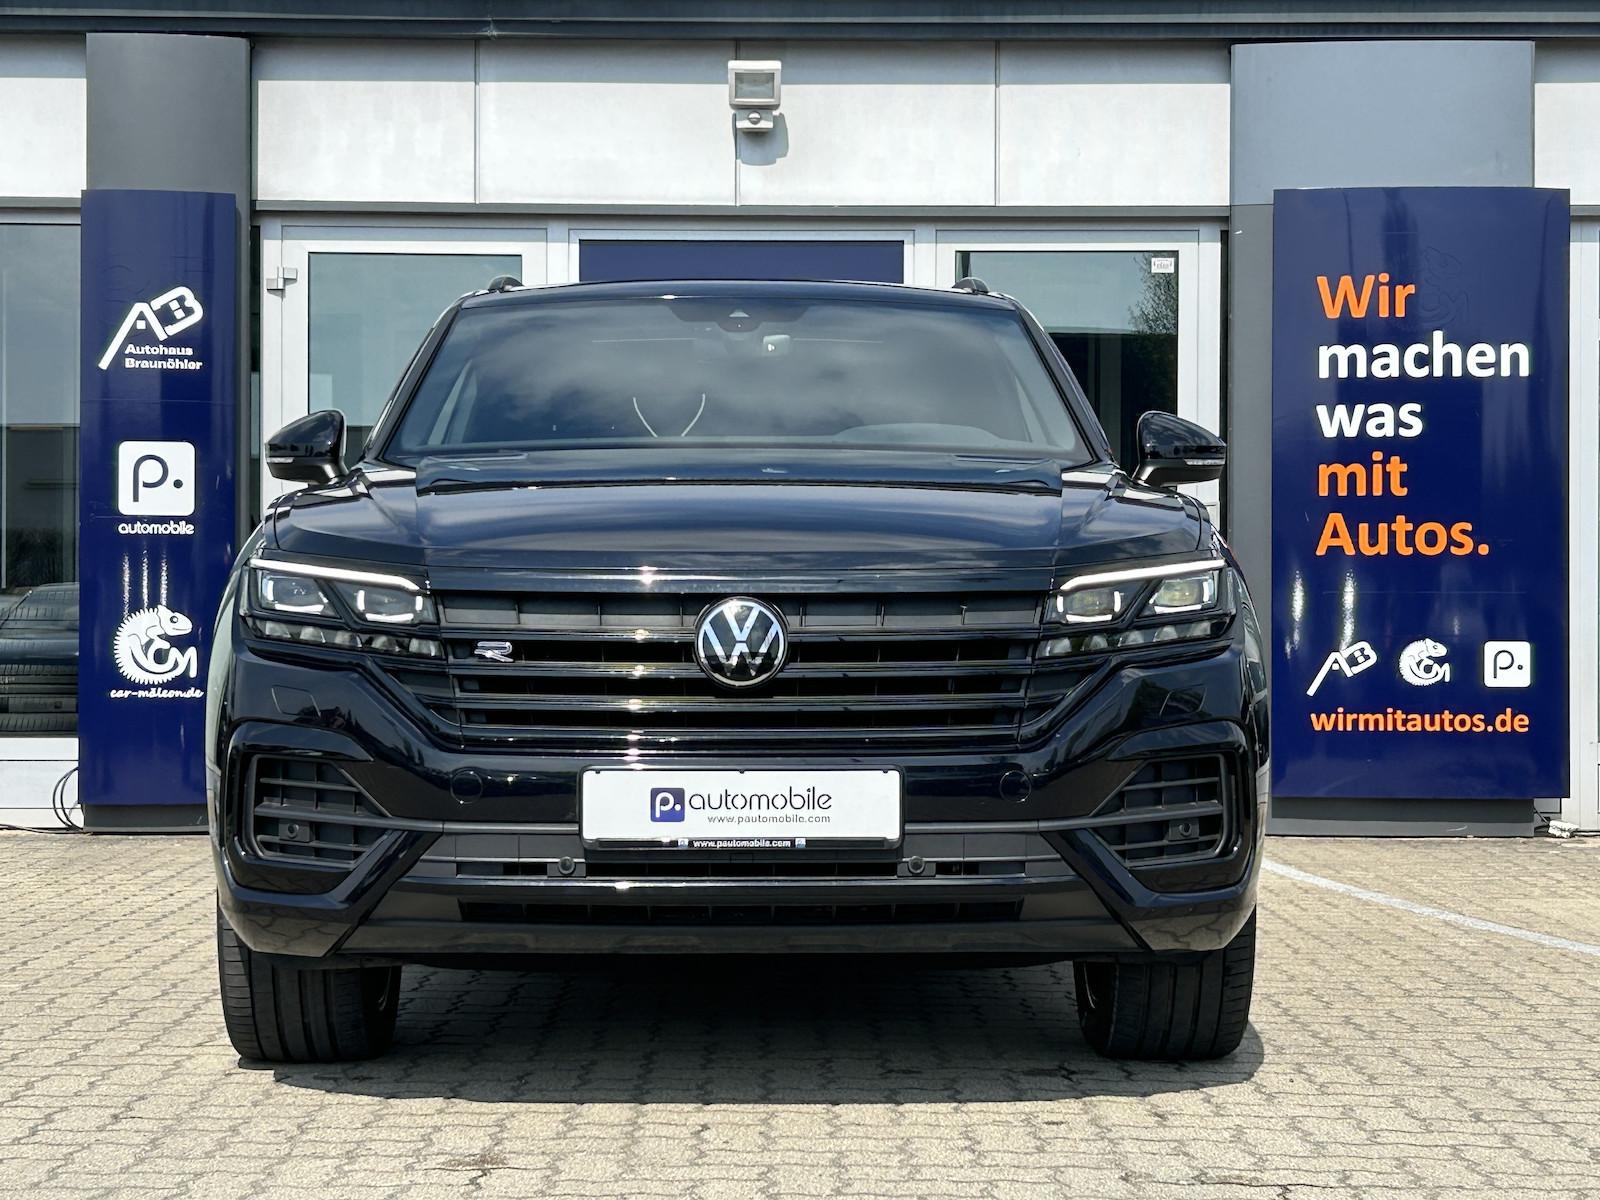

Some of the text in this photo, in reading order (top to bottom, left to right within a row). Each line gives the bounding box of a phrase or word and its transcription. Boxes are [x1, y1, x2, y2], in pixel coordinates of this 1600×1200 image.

[1316, 272, 1416, 319] Wir
[124, 343, 194, 356] Autohaus
[1318, 330, 1530, 379] machen
[124, 357, 203, 370] Braunöhler
[1315, 402, 1424, 438] was
[1318, 451, 1408, 497] mit
[117, 520, 195, 535] automobile
[1315, 512, 1490, 556] Autos.
[1310, 707, 1530, 733] wirmitautos.de
[688, 786, 832, 811] automobile
[707, 813, 831, 825] www.pautomobile.com
[692, 838, 791, 849] www.pautomobile.com
